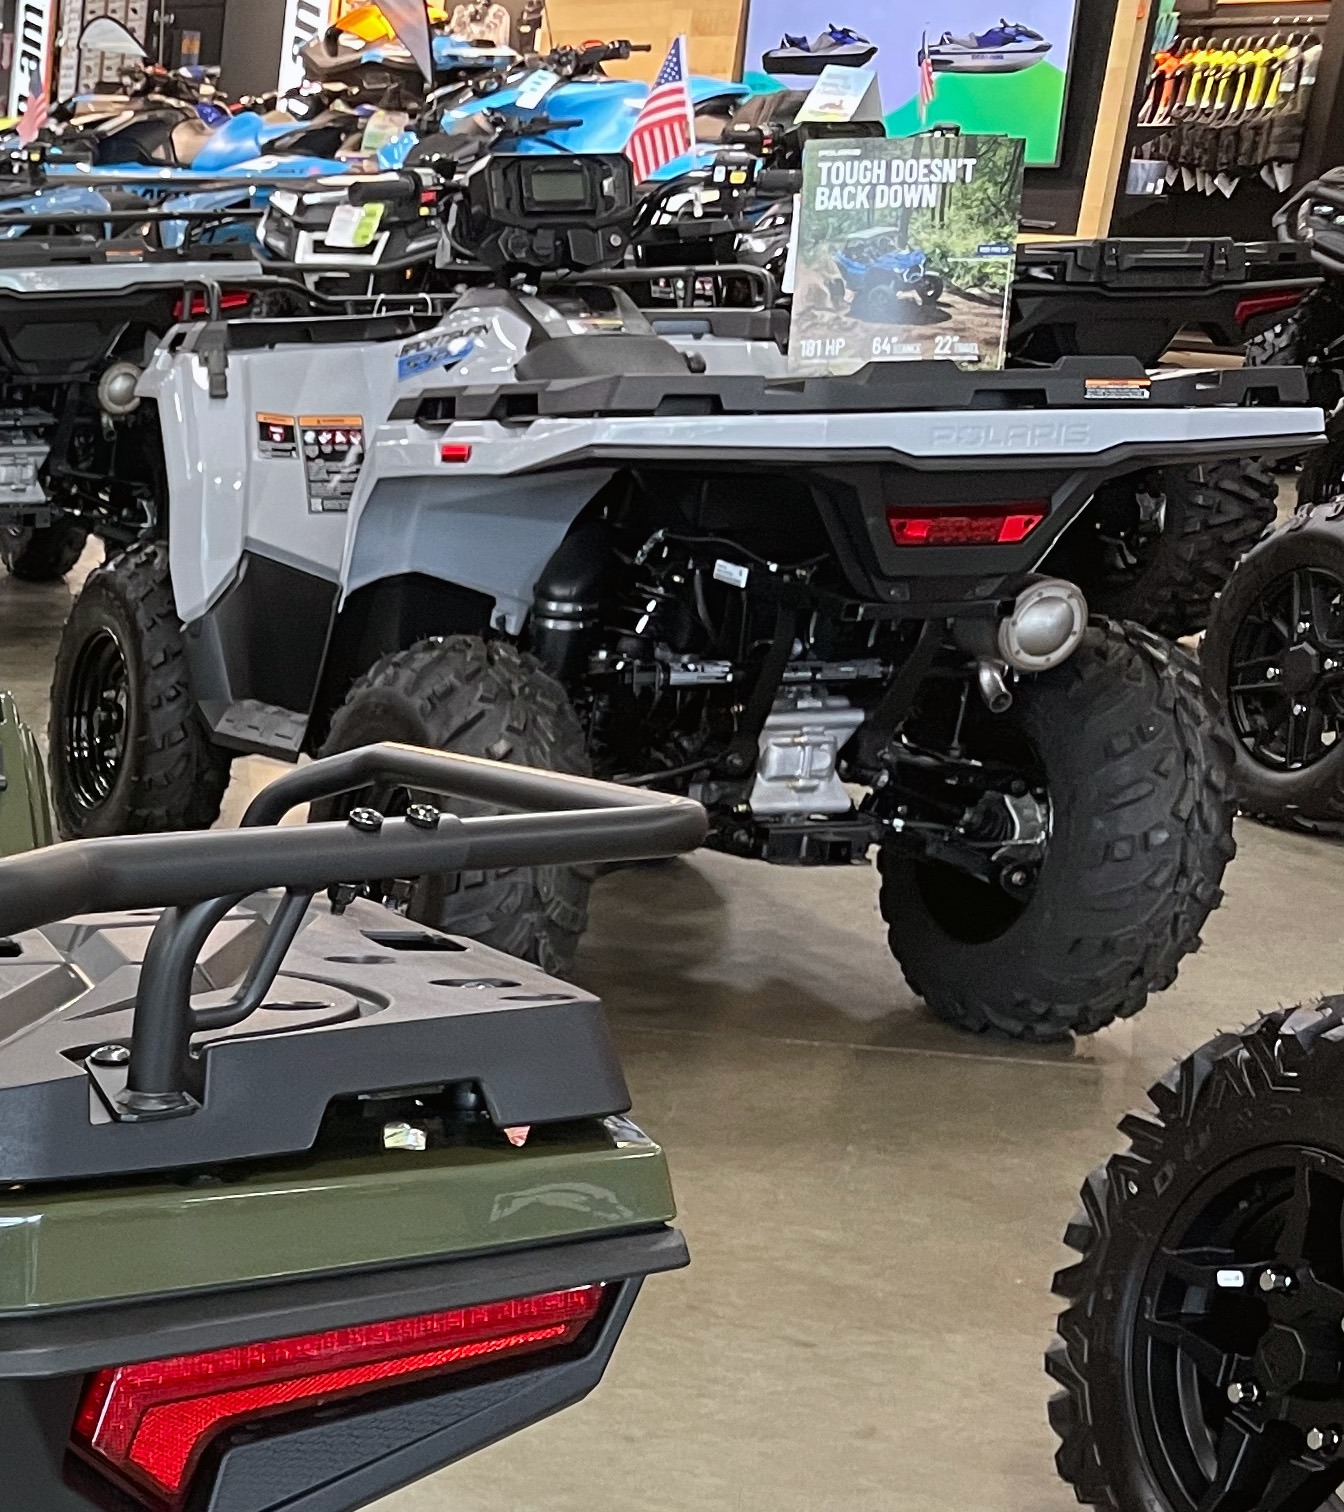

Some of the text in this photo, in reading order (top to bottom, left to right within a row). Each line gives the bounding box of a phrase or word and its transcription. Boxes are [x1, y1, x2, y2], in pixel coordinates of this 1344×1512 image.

[817, 158, 977, 186] TOUGH DOESN'T
[815, 184, 937, 211] BACK DOWN
[825, 338, 846, 356] HP
[930, 423, 1091, 448] POLARIS
